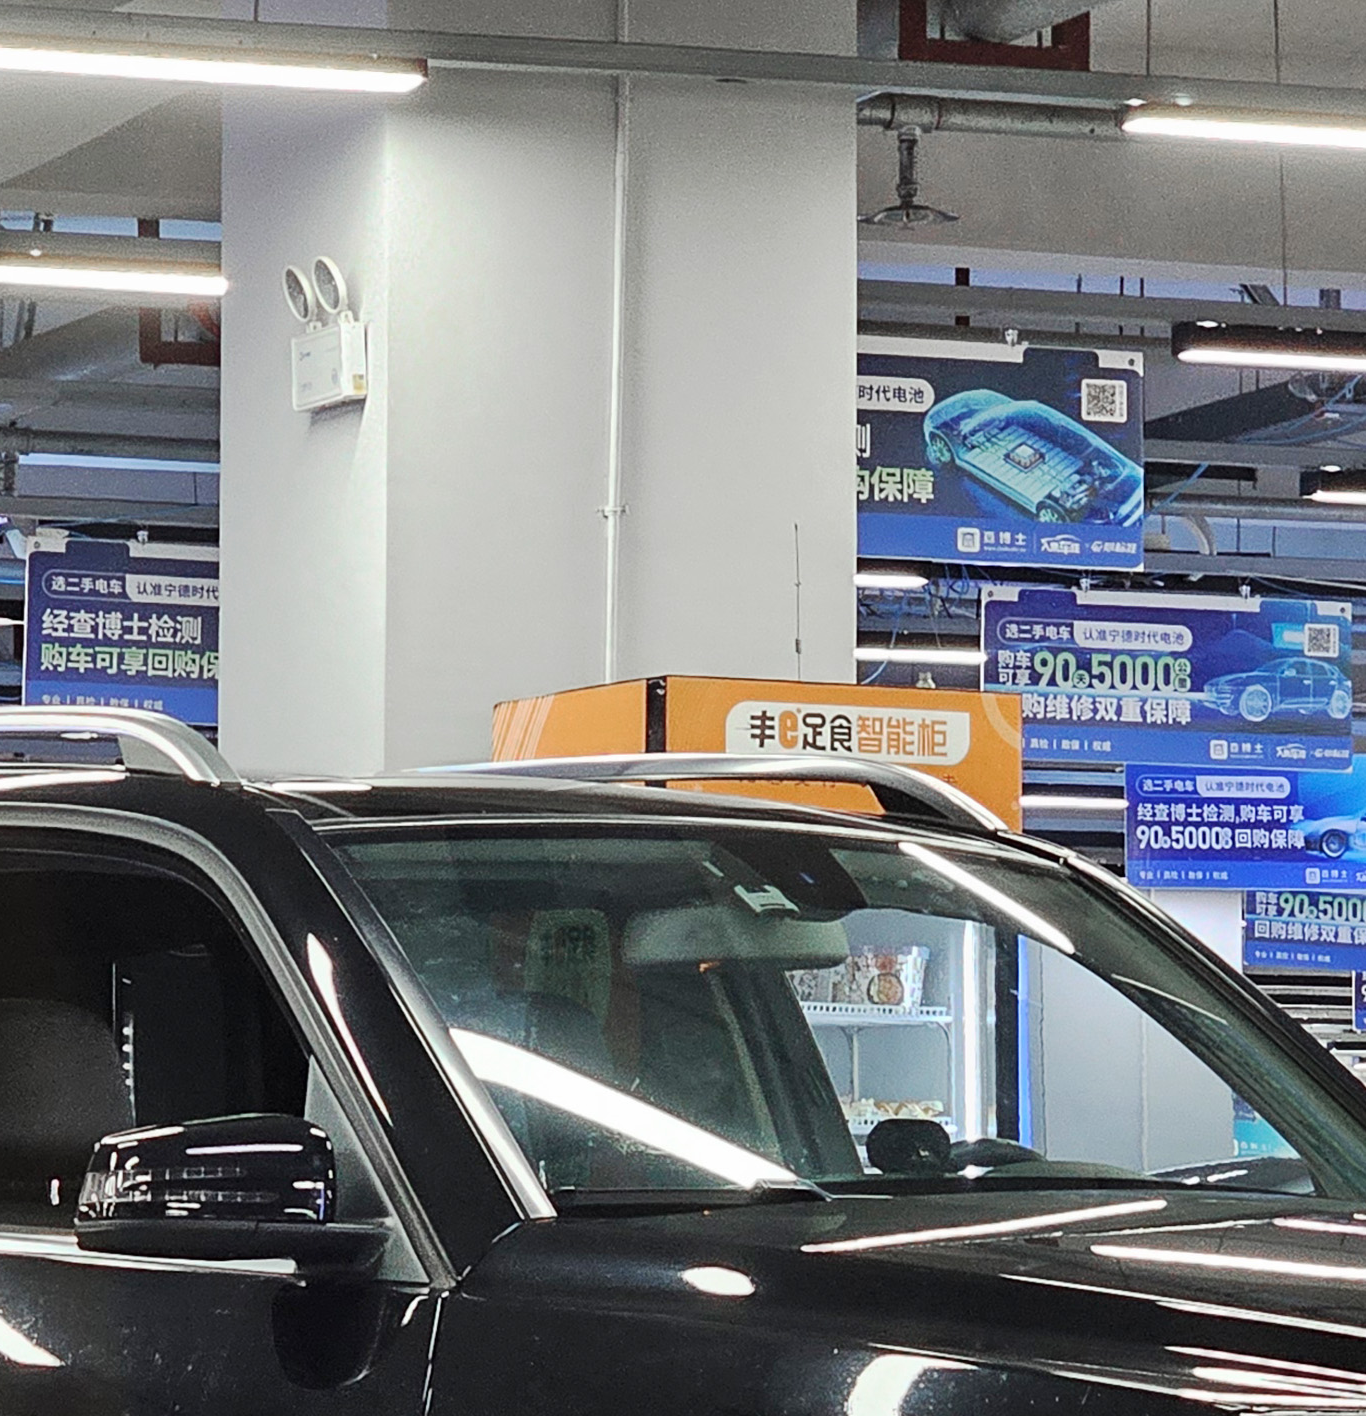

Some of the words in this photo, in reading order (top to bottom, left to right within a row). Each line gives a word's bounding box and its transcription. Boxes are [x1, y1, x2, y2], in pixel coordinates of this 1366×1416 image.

[51, 575, 123, 595] 选二手电车
[40, 608, 203, 645] 经查博士检测
[1004, 623, 1072, 641] 选二手电车
[1082, 627, 1185, 647] 认准宁德时代电池
[40, 642, 219, 680] 购车可享回购保
[997, 650, 1032, 669] 购车
[997, 667, 1032, 687] 可享
[1235, 828, 1306, 849] 回购保障
